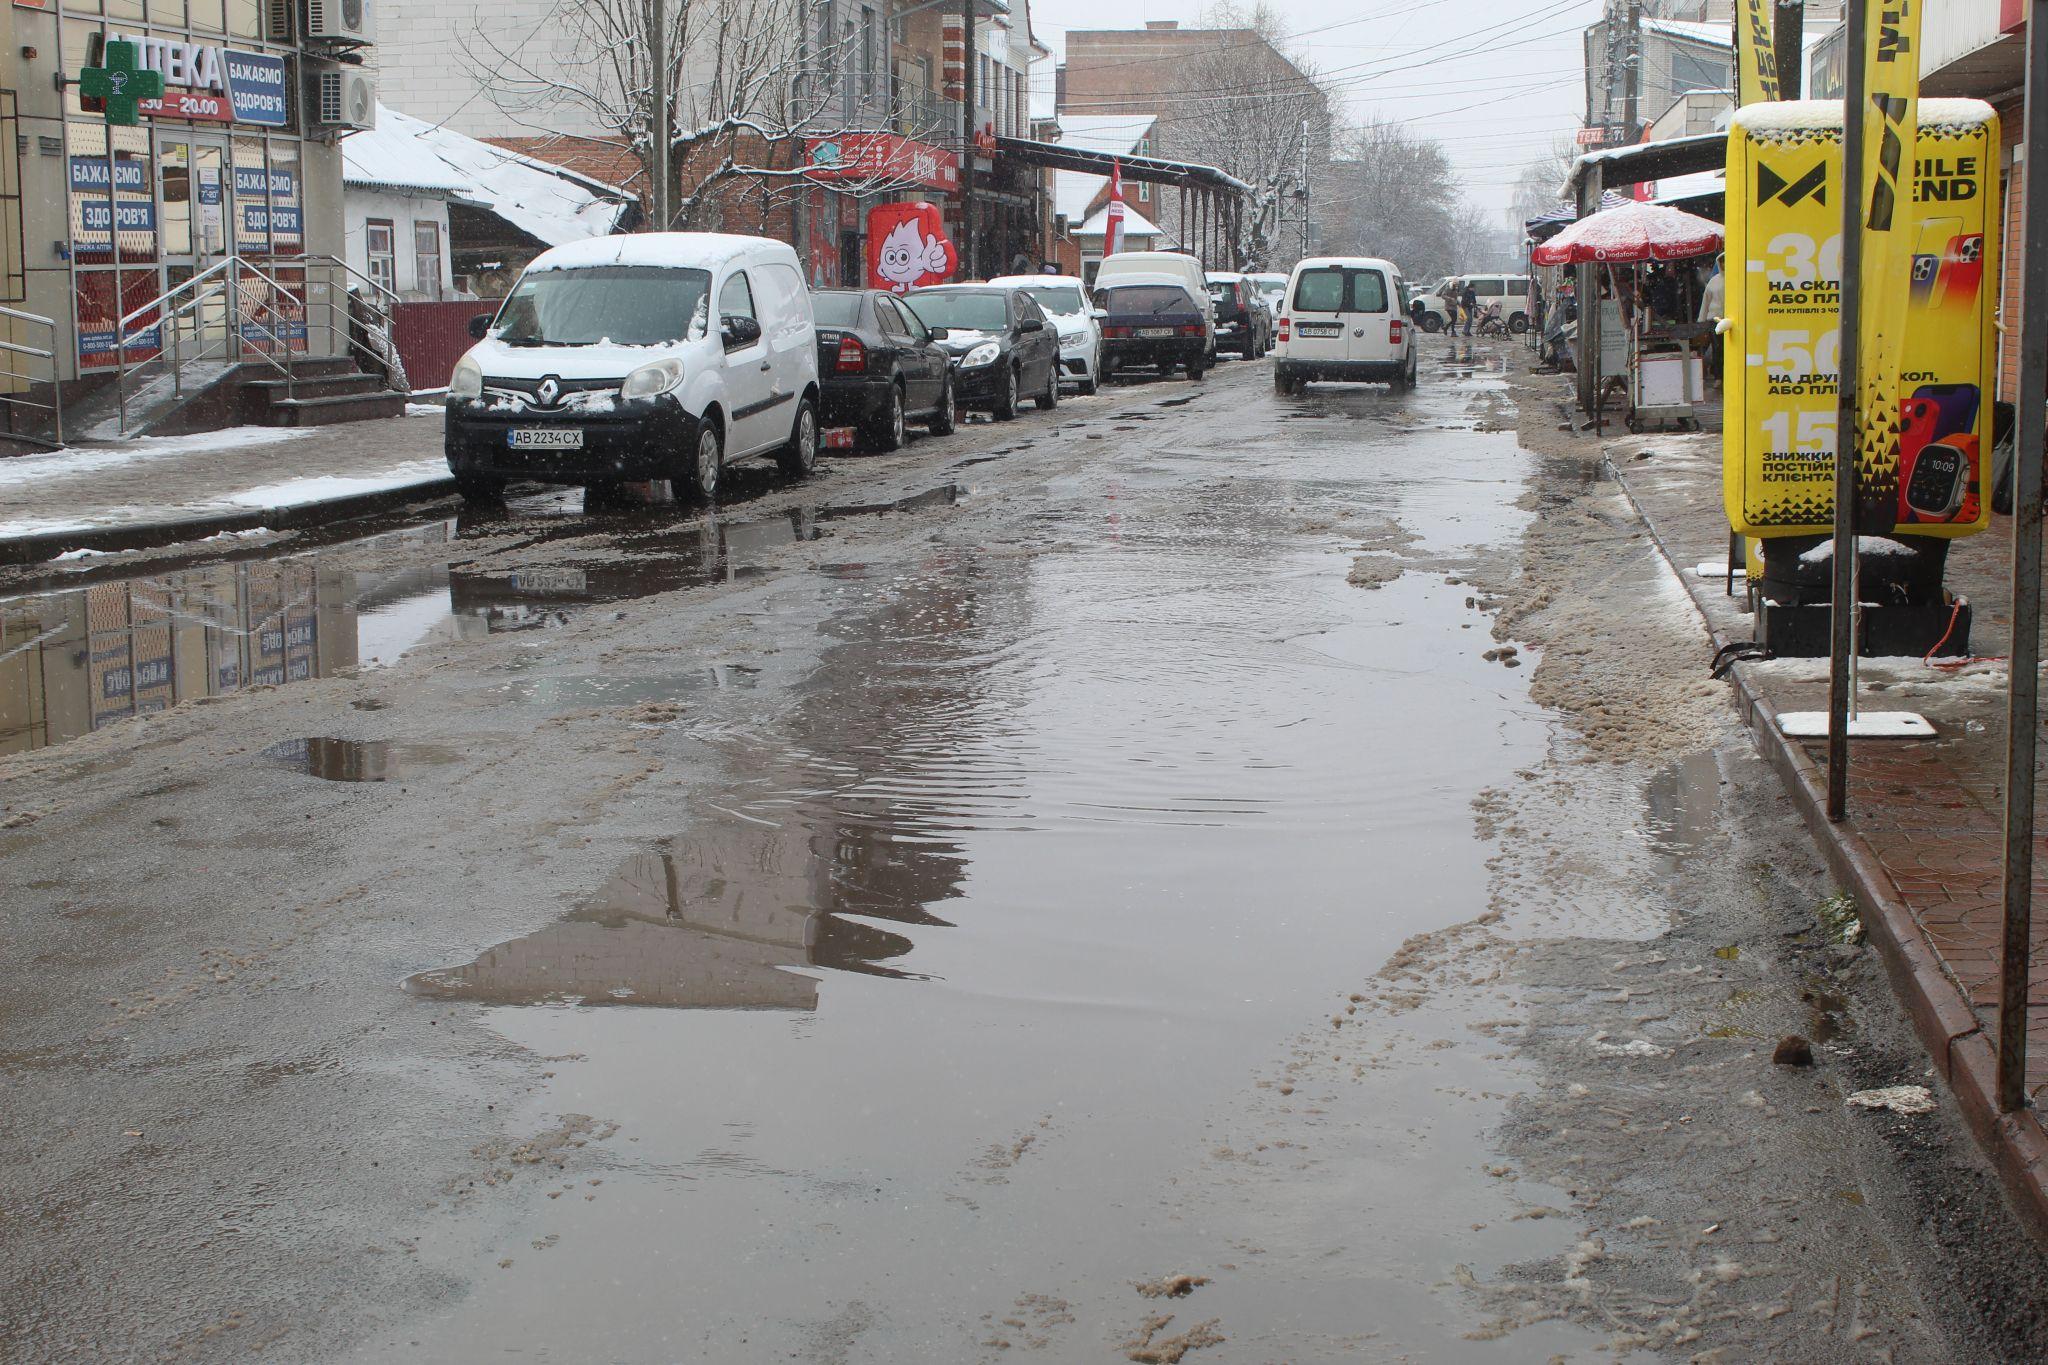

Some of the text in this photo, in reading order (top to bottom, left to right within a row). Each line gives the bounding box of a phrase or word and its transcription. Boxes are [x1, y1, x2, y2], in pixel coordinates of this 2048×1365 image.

[229, 62, 282, 85] БАЖАЄМО
[179, 98, 219, 115] 20.00
[234, 92, 284, 113] ЗДОРОВ'Я
[73, 164, 141, 184] БАЖАЄМО
[236, 173, 291, 191] БАЖАЄМО
[86, 207, 148, 228] ЗДОРОВ'Я
[247, 212, 297, 229] ЗДОРОВ'Я
[1607, 250, 1638, 258] vodafone
[1768, 281, 1794, 291] НА
[1768, 293, 1808, 304] АБО
[1768, 374, 1794, 383] НА
[1768, 385, 1804, 395] АБО
[515, 432, 580, 444] AB 2234 CX
[1762, 452, 1833, 461] ЗНИЖКИ
[1932, 460, 1955, 473] 10:09
[1762, 473, 1834, 483] КЛІЄНТА
